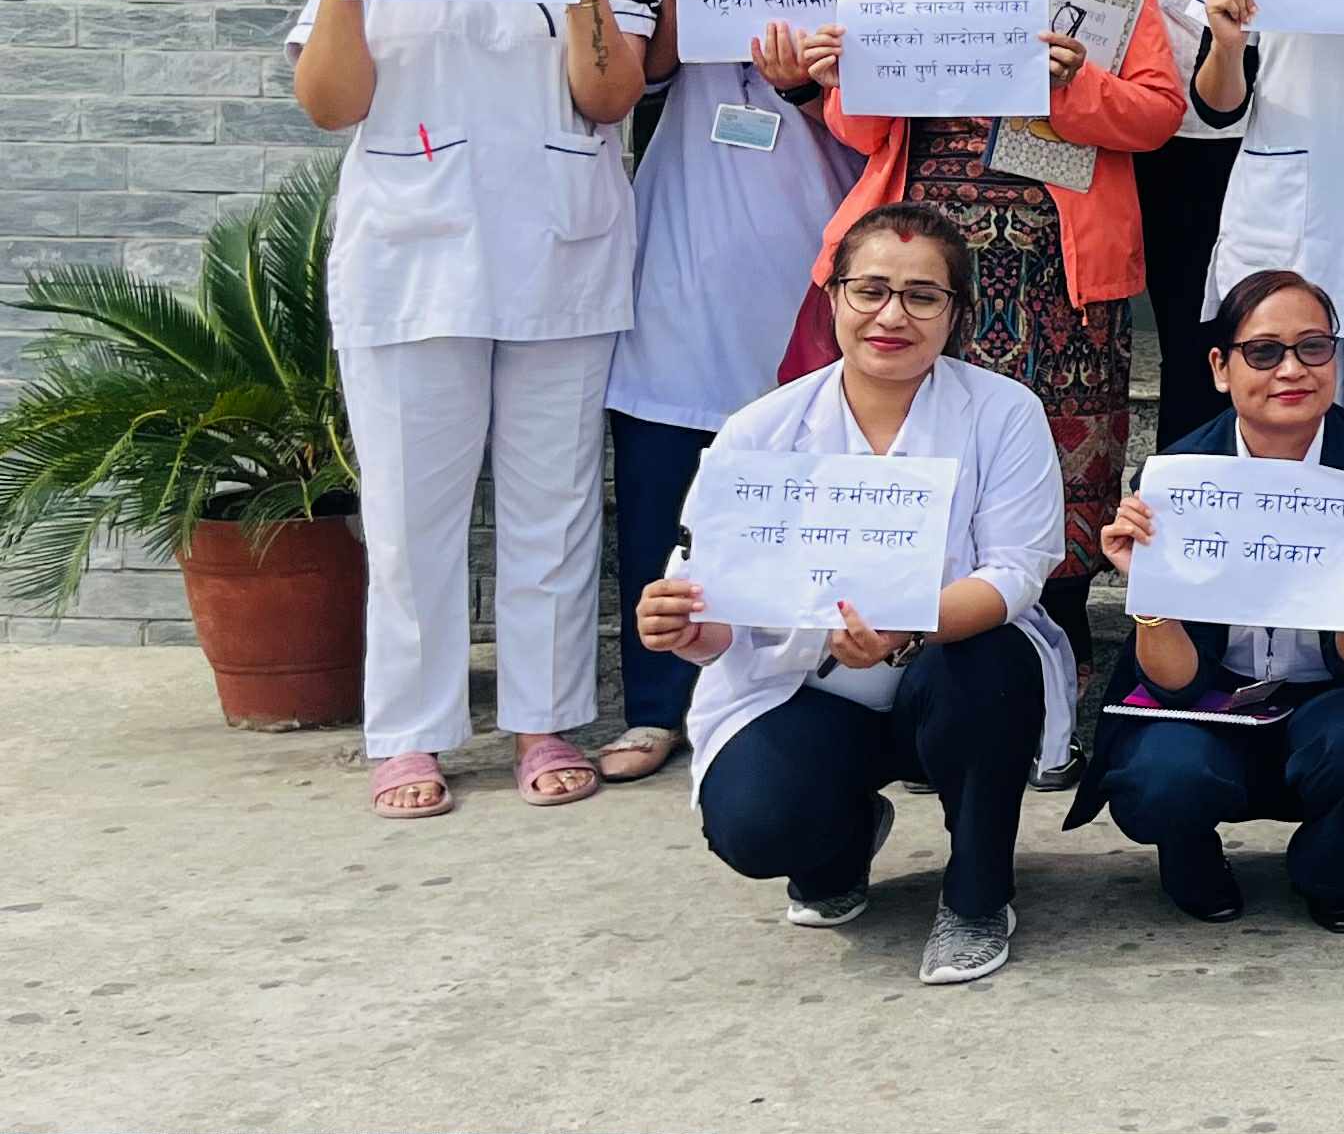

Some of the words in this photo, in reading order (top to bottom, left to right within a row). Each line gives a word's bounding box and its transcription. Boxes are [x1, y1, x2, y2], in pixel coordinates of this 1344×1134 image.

[913, 0, 967, 15] स्वास्थ्य
[933, 27, 997, 46] आन्दोलन
[1002, 26, 1030, 45] प्रति
[943, 58, 993, 77] समर्थन
[997, 62, 1015, 80] छ
[734, 476, 774, 501] सेवा
[783, 477, 819, 503] दिने
[1167, 481, 1244, 516] सुरक्षित
[799, 527, 851, 546] समान
[860, 528, 919, 548] व्यहार
[1243, 534, 1326, 564] अधिकार
[809, 569, 838, 587] गर
